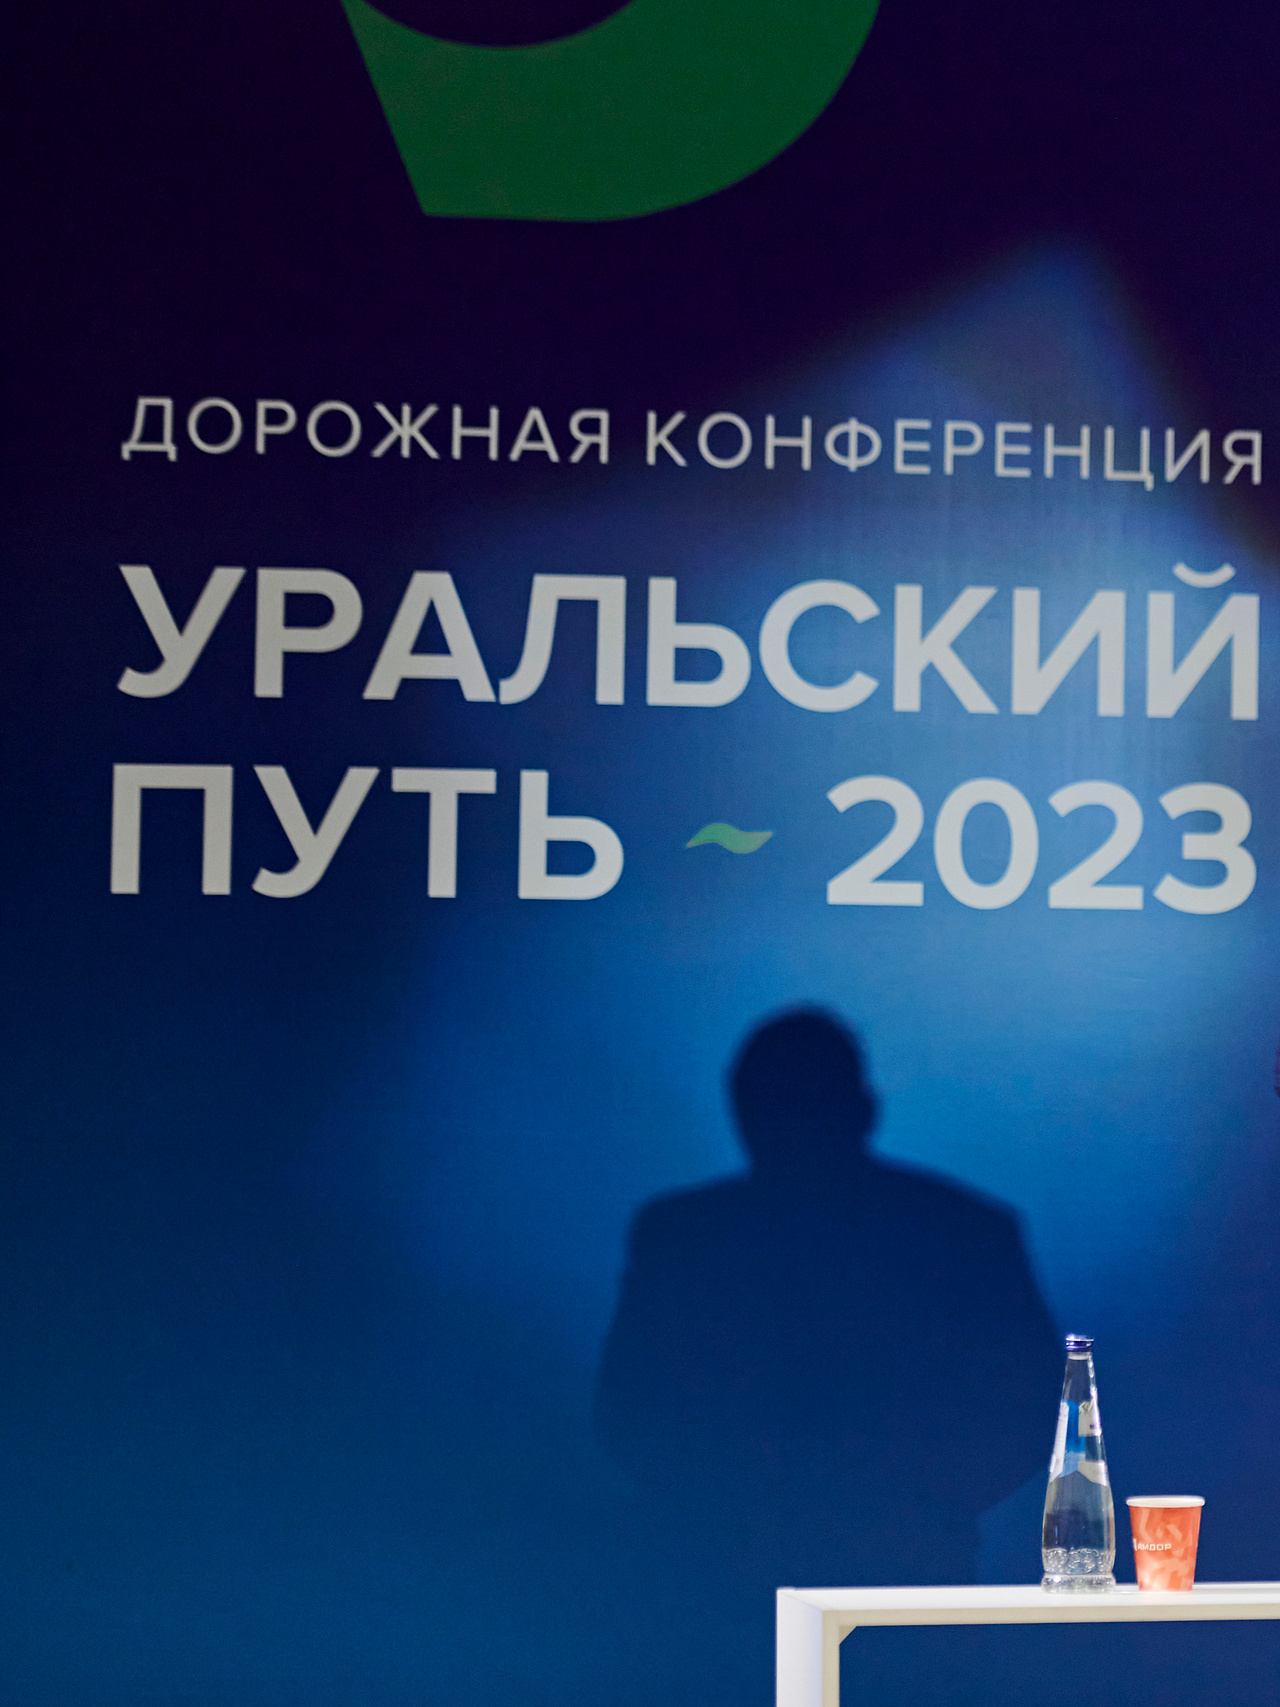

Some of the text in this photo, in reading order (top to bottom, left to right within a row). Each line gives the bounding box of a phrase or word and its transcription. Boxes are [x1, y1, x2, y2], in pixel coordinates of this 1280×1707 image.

[122, 397, 1262, 491] ДОРОЖНАЯ КОНФЕРЕНЦИЯ
[117, 563, 1260, 720] УРАЛЬСКИЙ
[110, 764, 1257, 915] ПУТЬ 2023
